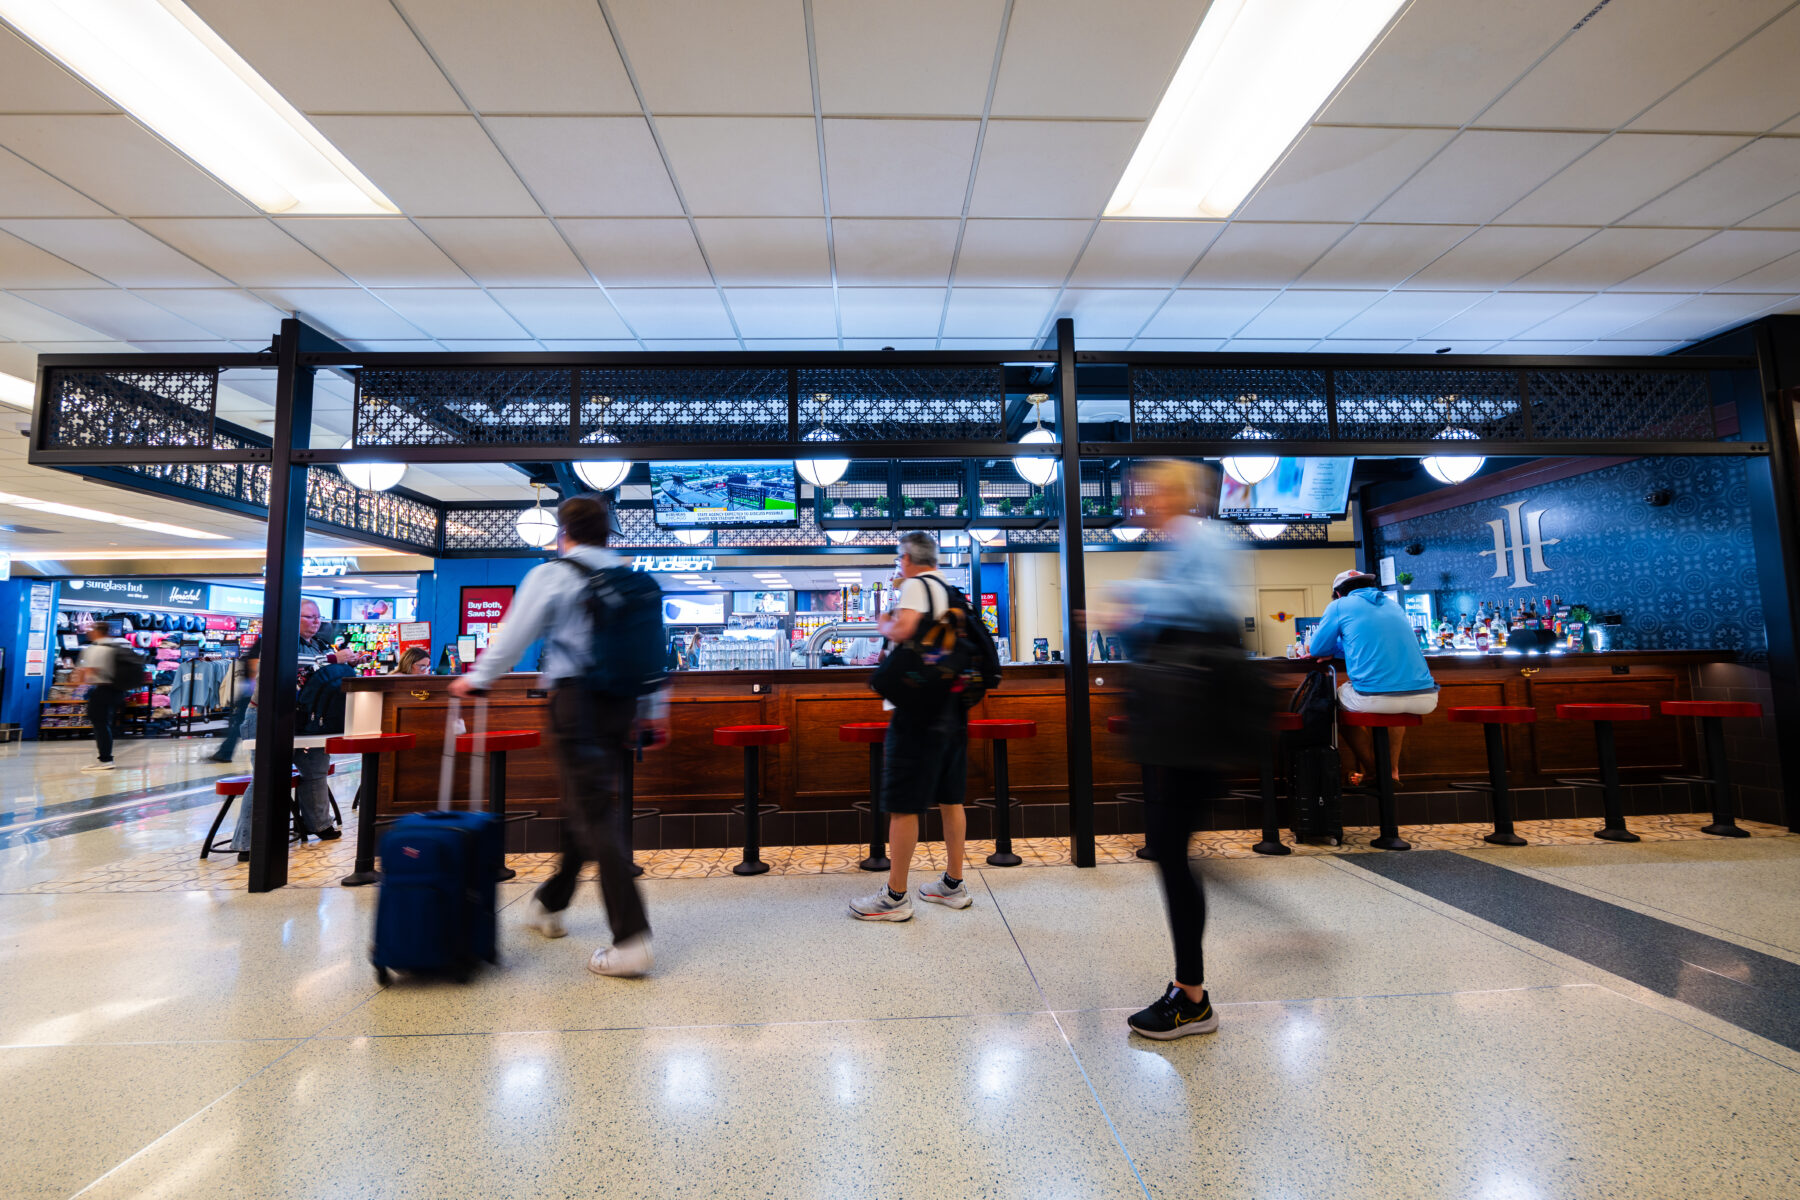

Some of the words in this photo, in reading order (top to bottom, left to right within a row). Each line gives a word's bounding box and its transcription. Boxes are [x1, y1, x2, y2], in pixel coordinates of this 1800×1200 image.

[632, 556, 713, 572] Hudson
[86, 580, 127, 592] sunglass
[127, 582, 143, 593] hut
[483, 601, 502, 609] Both,
[486, 610, 501, 618] $10
